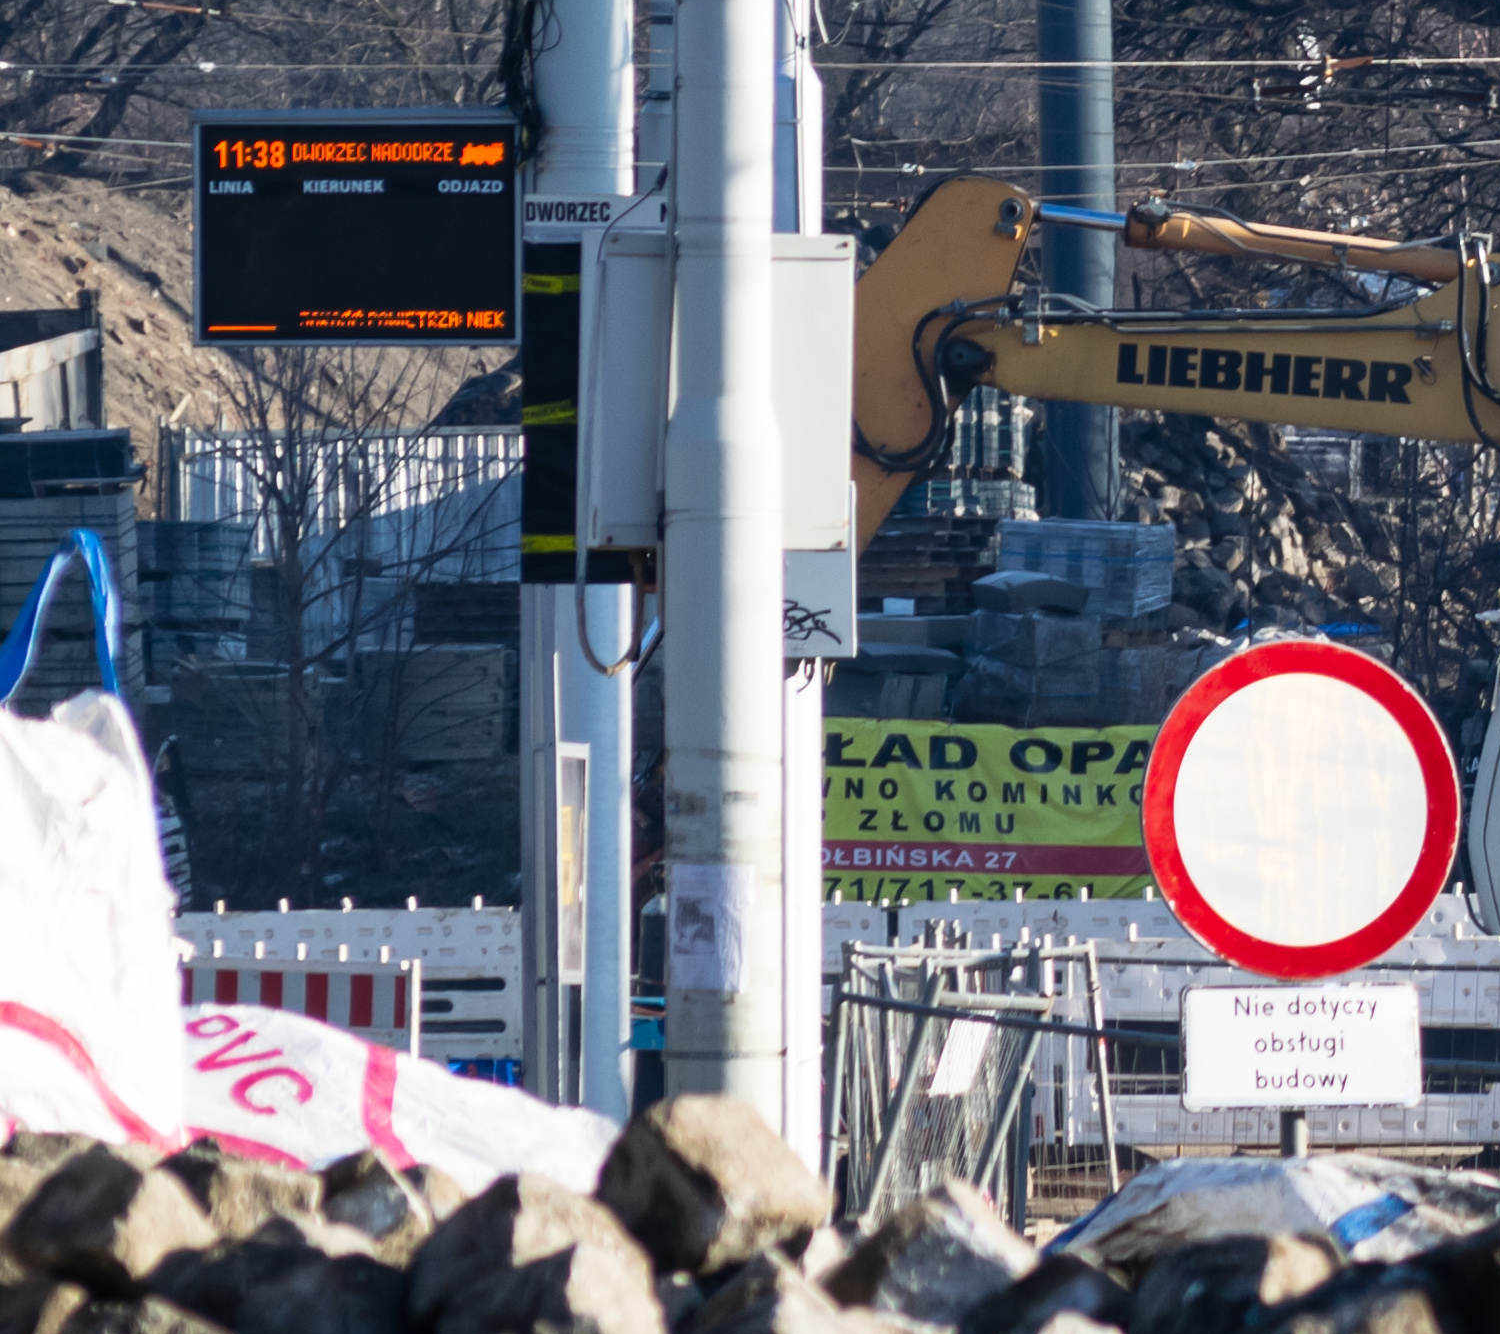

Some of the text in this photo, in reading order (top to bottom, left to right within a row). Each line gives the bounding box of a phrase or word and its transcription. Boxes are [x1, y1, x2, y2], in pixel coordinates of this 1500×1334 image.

[213, 141, 286, 168] 11:38
[292, 142, 368, 162] DWORZEC
[371, 142, 455, 162] NADODRZE
[209, 179, 504, 194] LINIA KIERUNEK ODJAZD
[525, 201, 612, 224] DWORZEC
[1116, 342, 1413, 405] LIEBHERR
[822, 732, 978, 771] ŁAD
[858, 808, 1015, 835] ZŁOMU
[984, 850, 1018, 869] 27
[1234, 994, 1378, 1020] Nie dotyczy
[1254, 1029, 1345, 1058] obsługi
[1255, 1067, 1349, 1094] budowy
